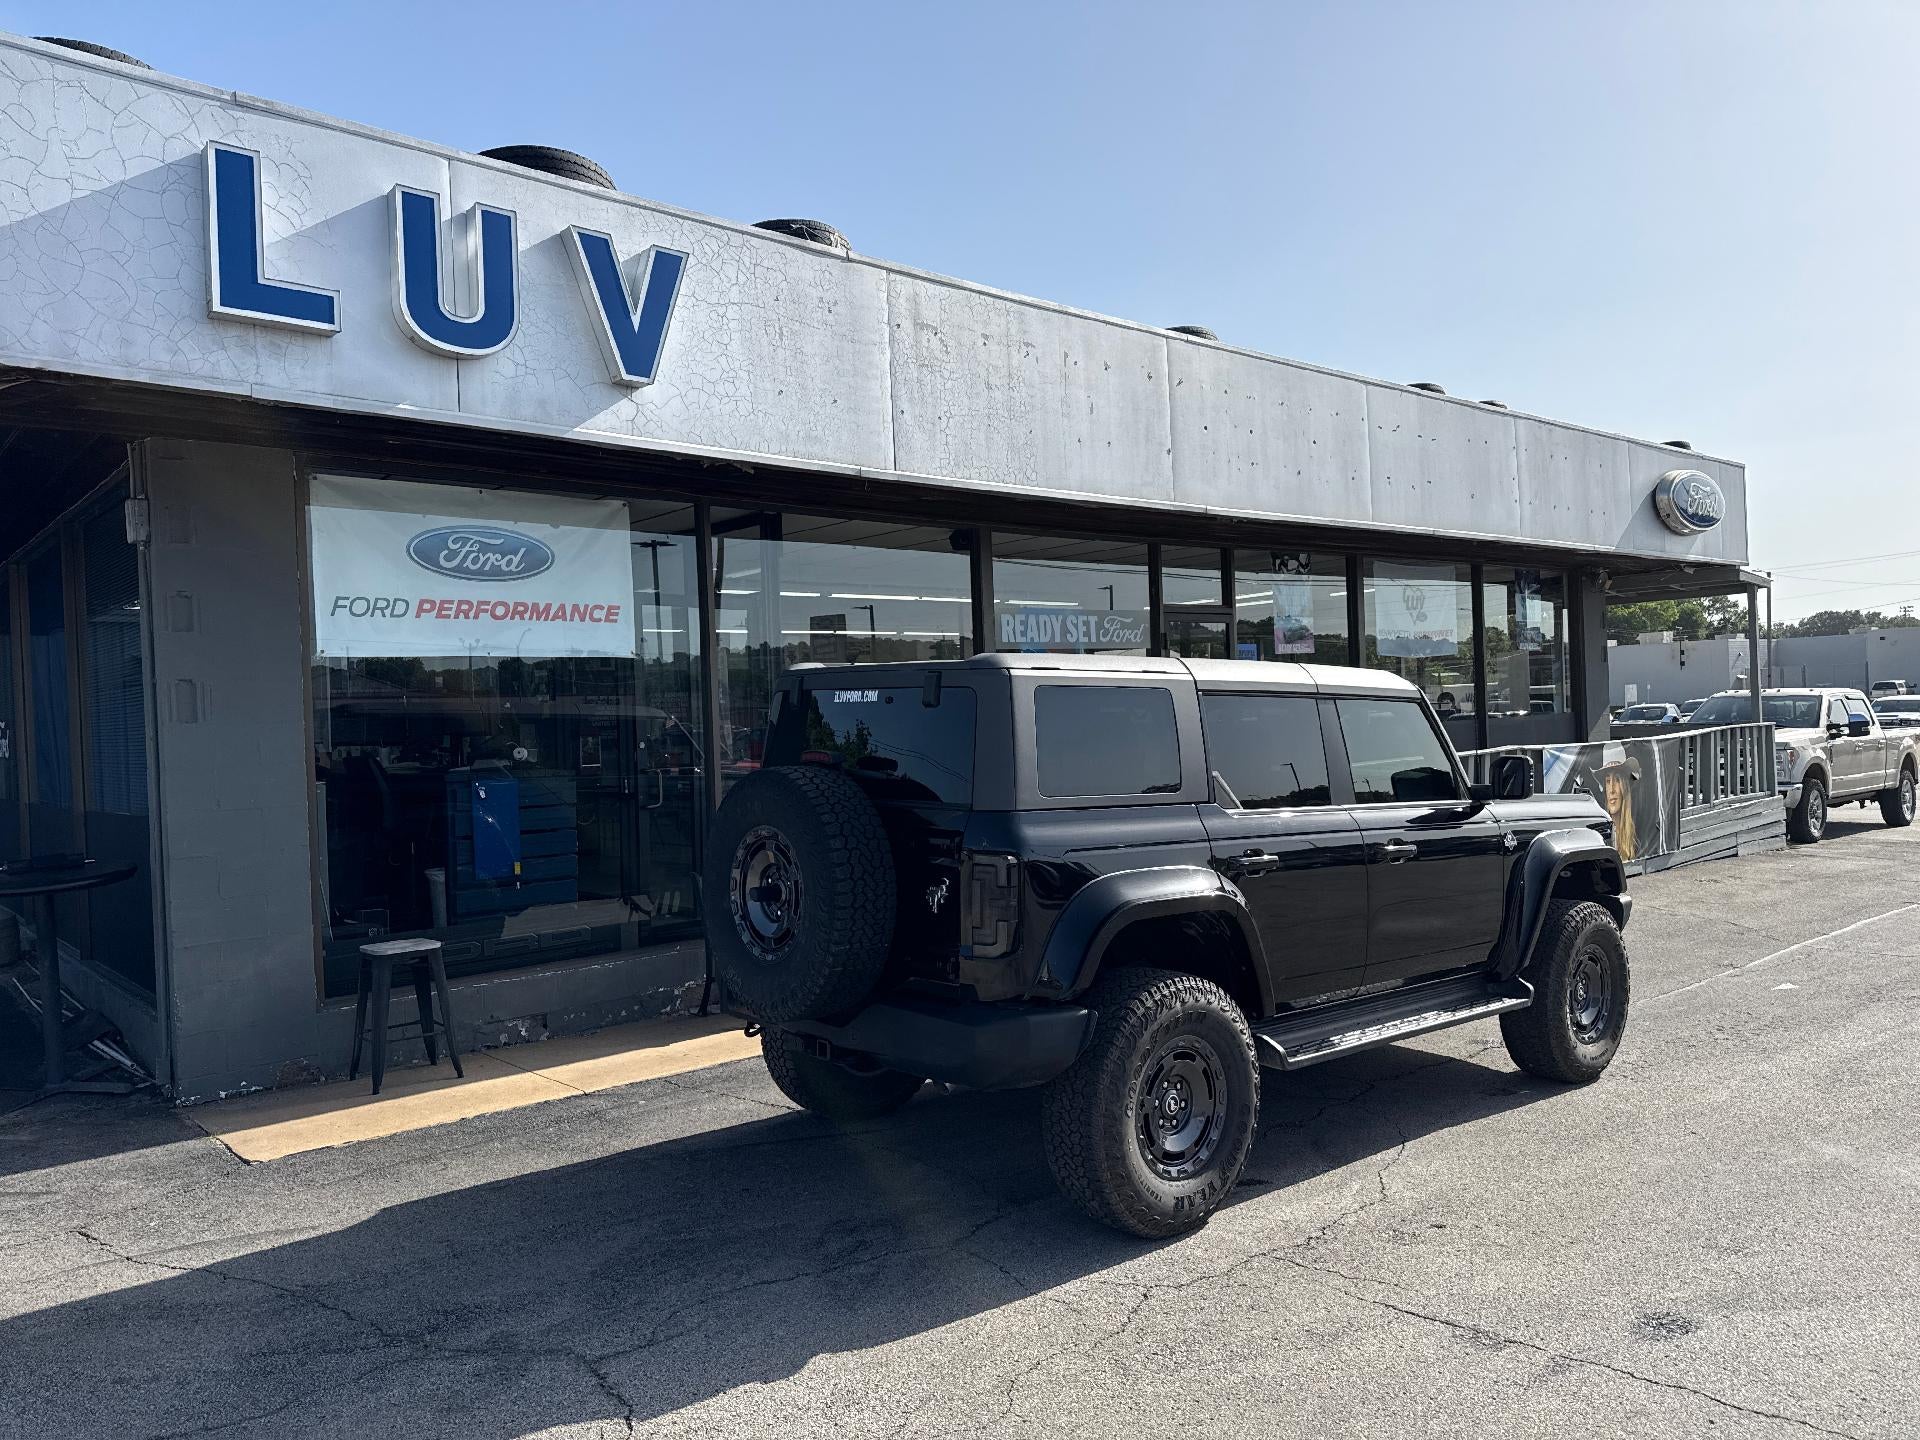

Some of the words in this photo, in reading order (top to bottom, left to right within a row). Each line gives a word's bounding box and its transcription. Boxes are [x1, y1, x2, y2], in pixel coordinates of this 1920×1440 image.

[201, 140, 689, 387] LUV
[439, 533, 526, 572] Ford
[329, 596, 410, 618] FORD
[414, 598, 621, 624] PERFORMANCE
[1001, 613, 1064, 643] READY
[1067, 614, 1098, 643] SET
[1100, 615, 1145, 643] Ford
